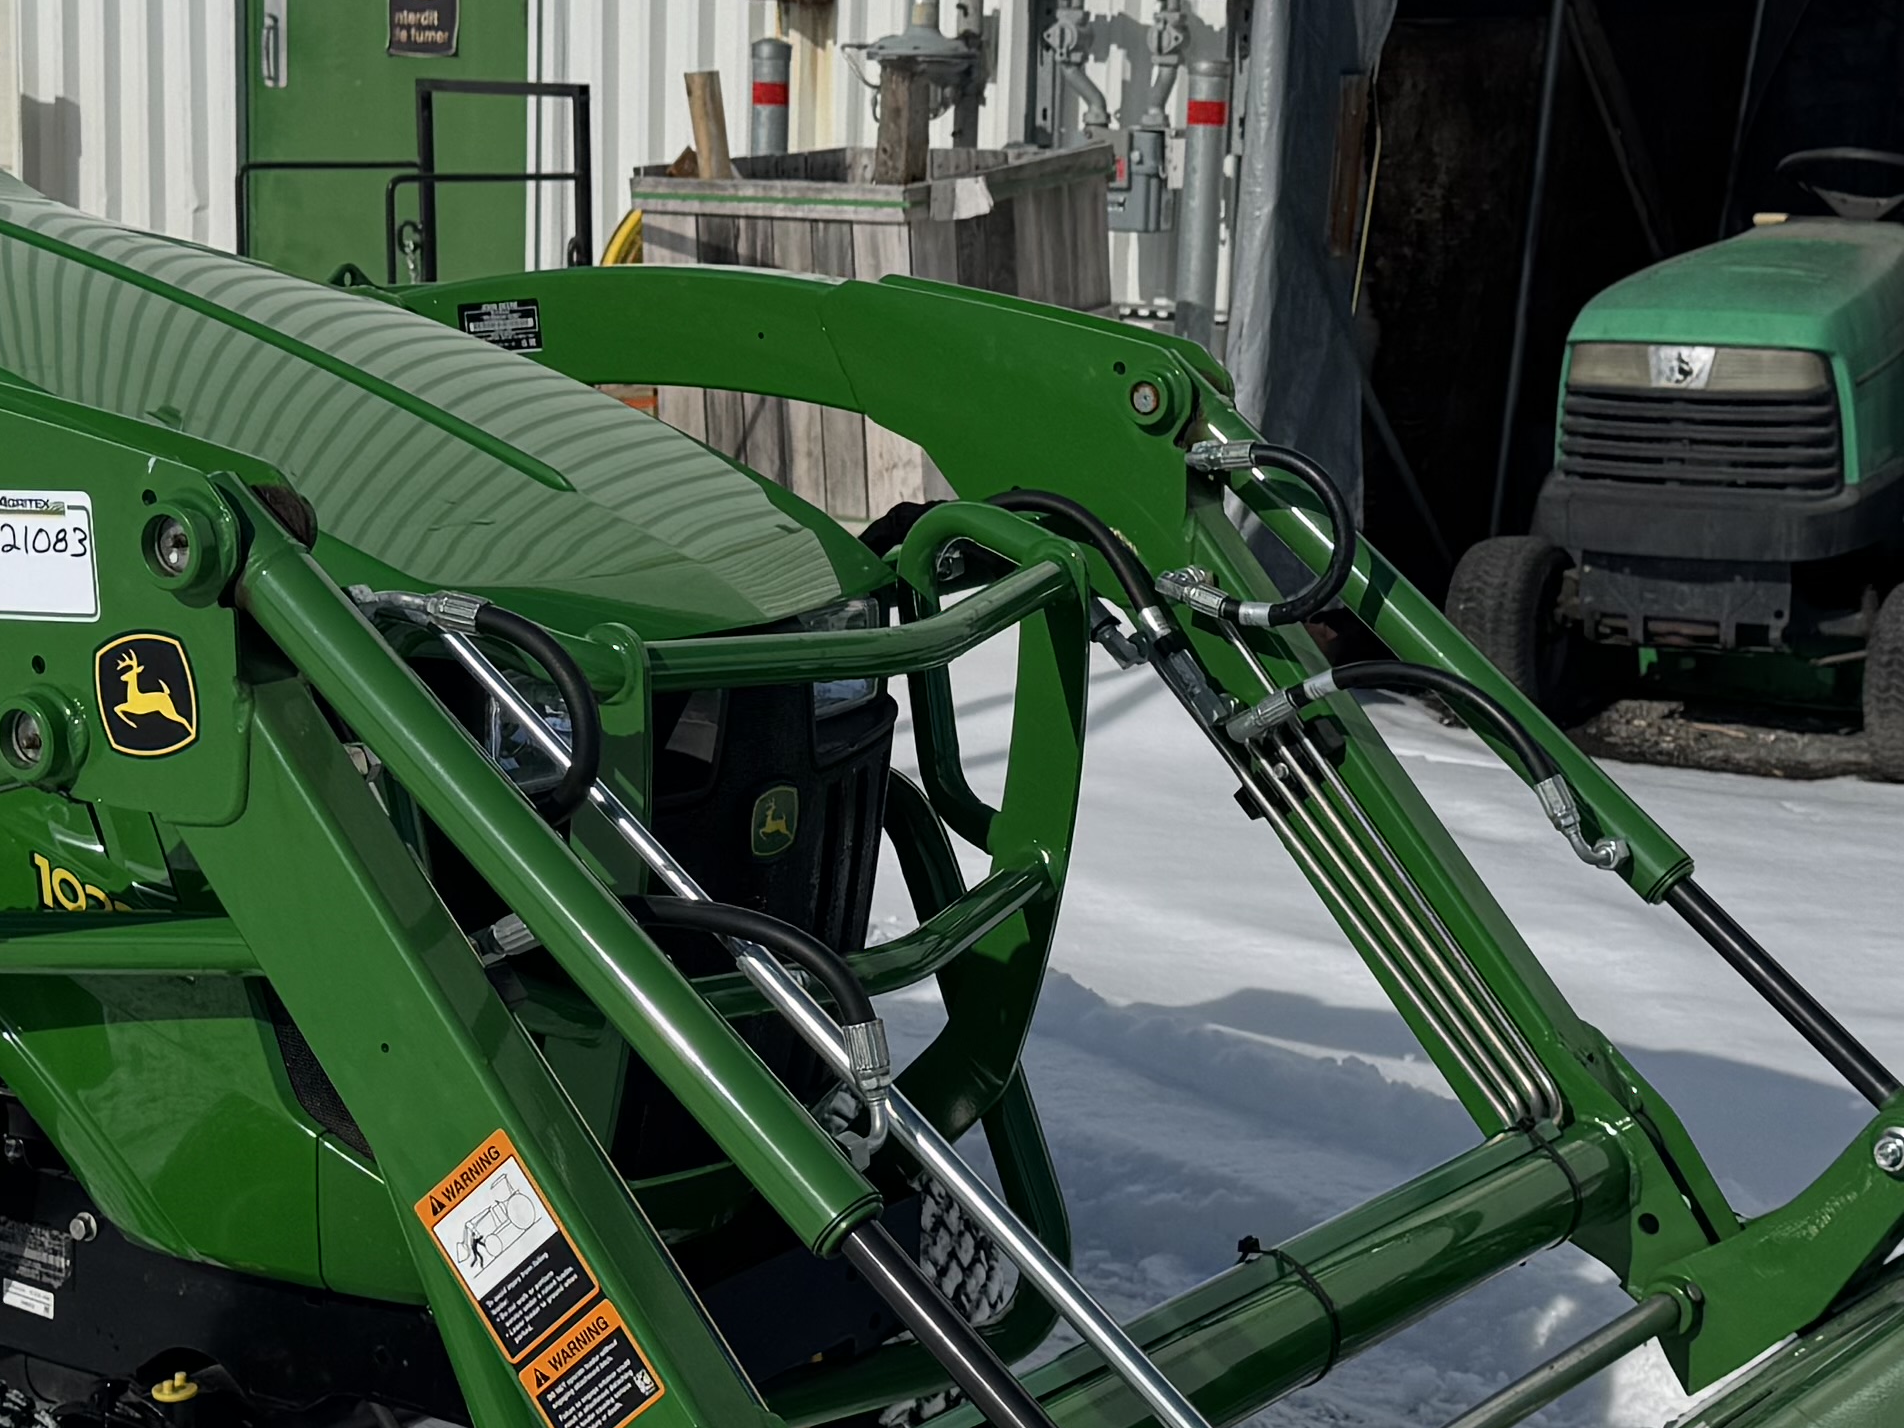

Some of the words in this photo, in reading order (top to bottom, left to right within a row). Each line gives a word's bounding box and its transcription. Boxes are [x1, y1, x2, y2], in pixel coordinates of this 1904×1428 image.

[394, 9, 438, 26] nterdit
[411, 28, 449, 44] fumer
[442, 1144, 501, 1202] WARNING
[548, 1315, 610, 1373] WARNING
